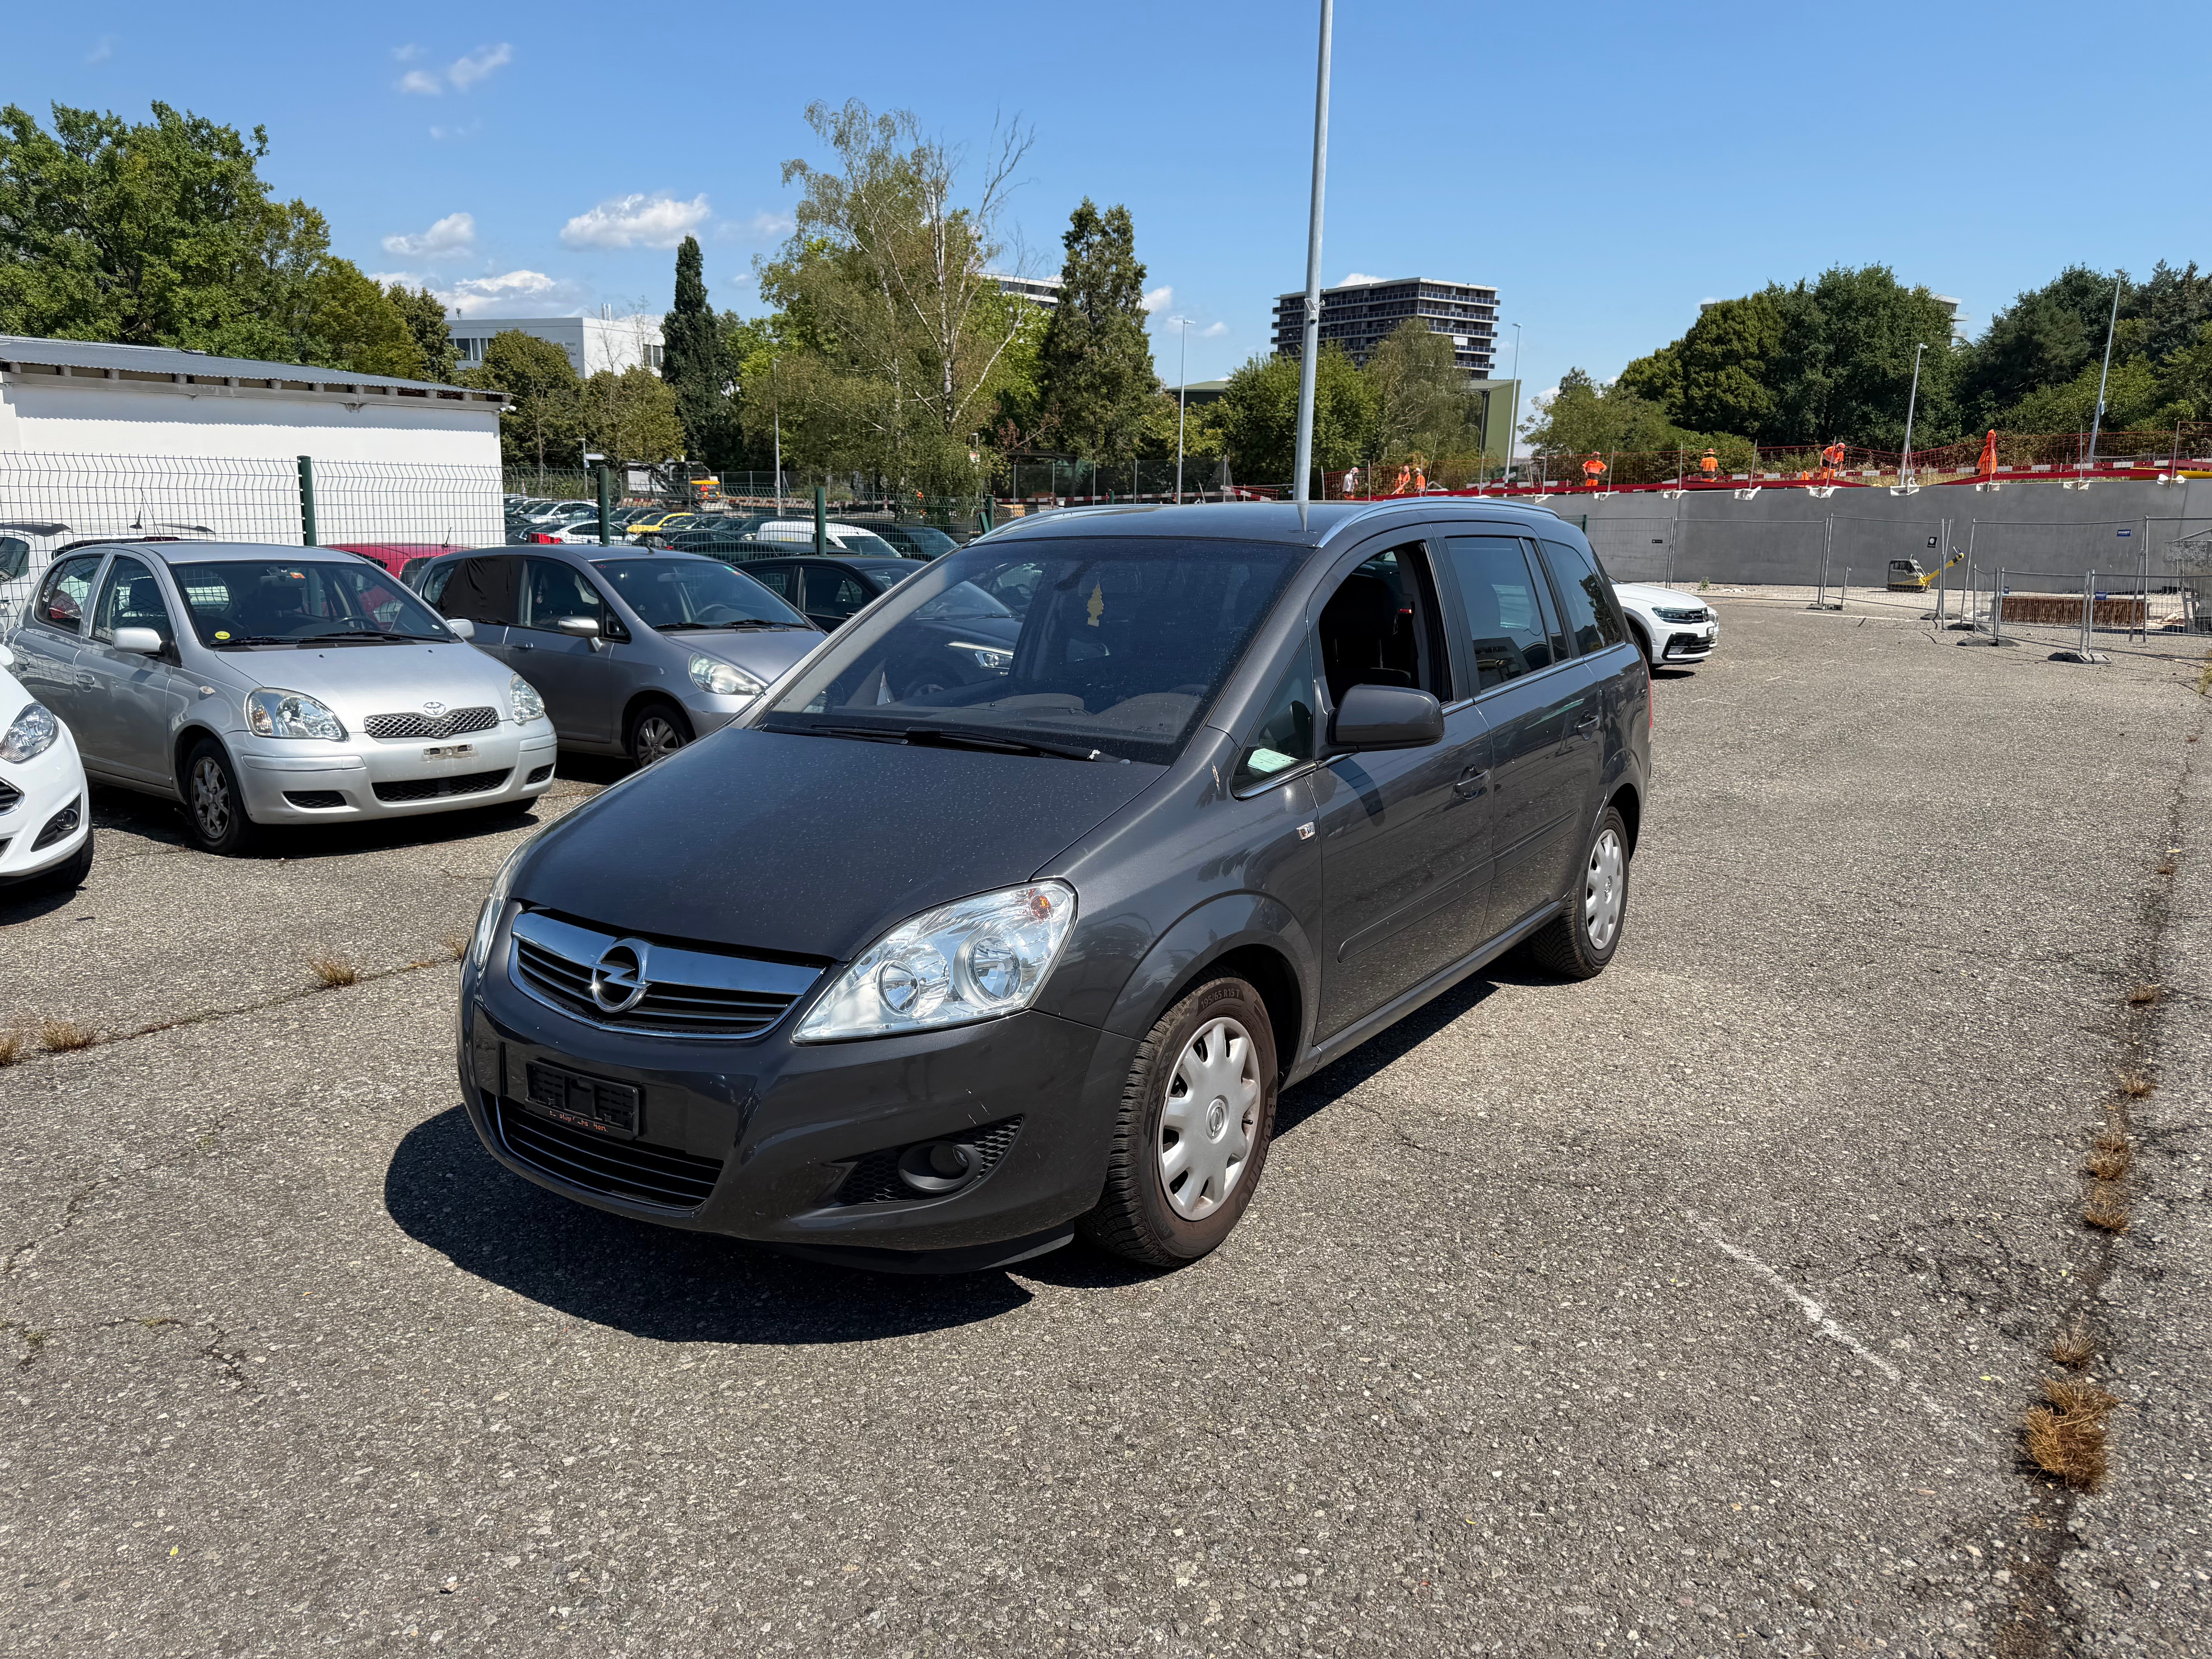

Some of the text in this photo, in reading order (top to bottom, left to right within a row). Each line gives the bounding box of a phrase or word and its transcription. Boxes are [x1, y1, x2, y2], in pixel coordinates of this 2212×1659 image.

[1201, 988, 1240, 1009] 195/65 R15 T
